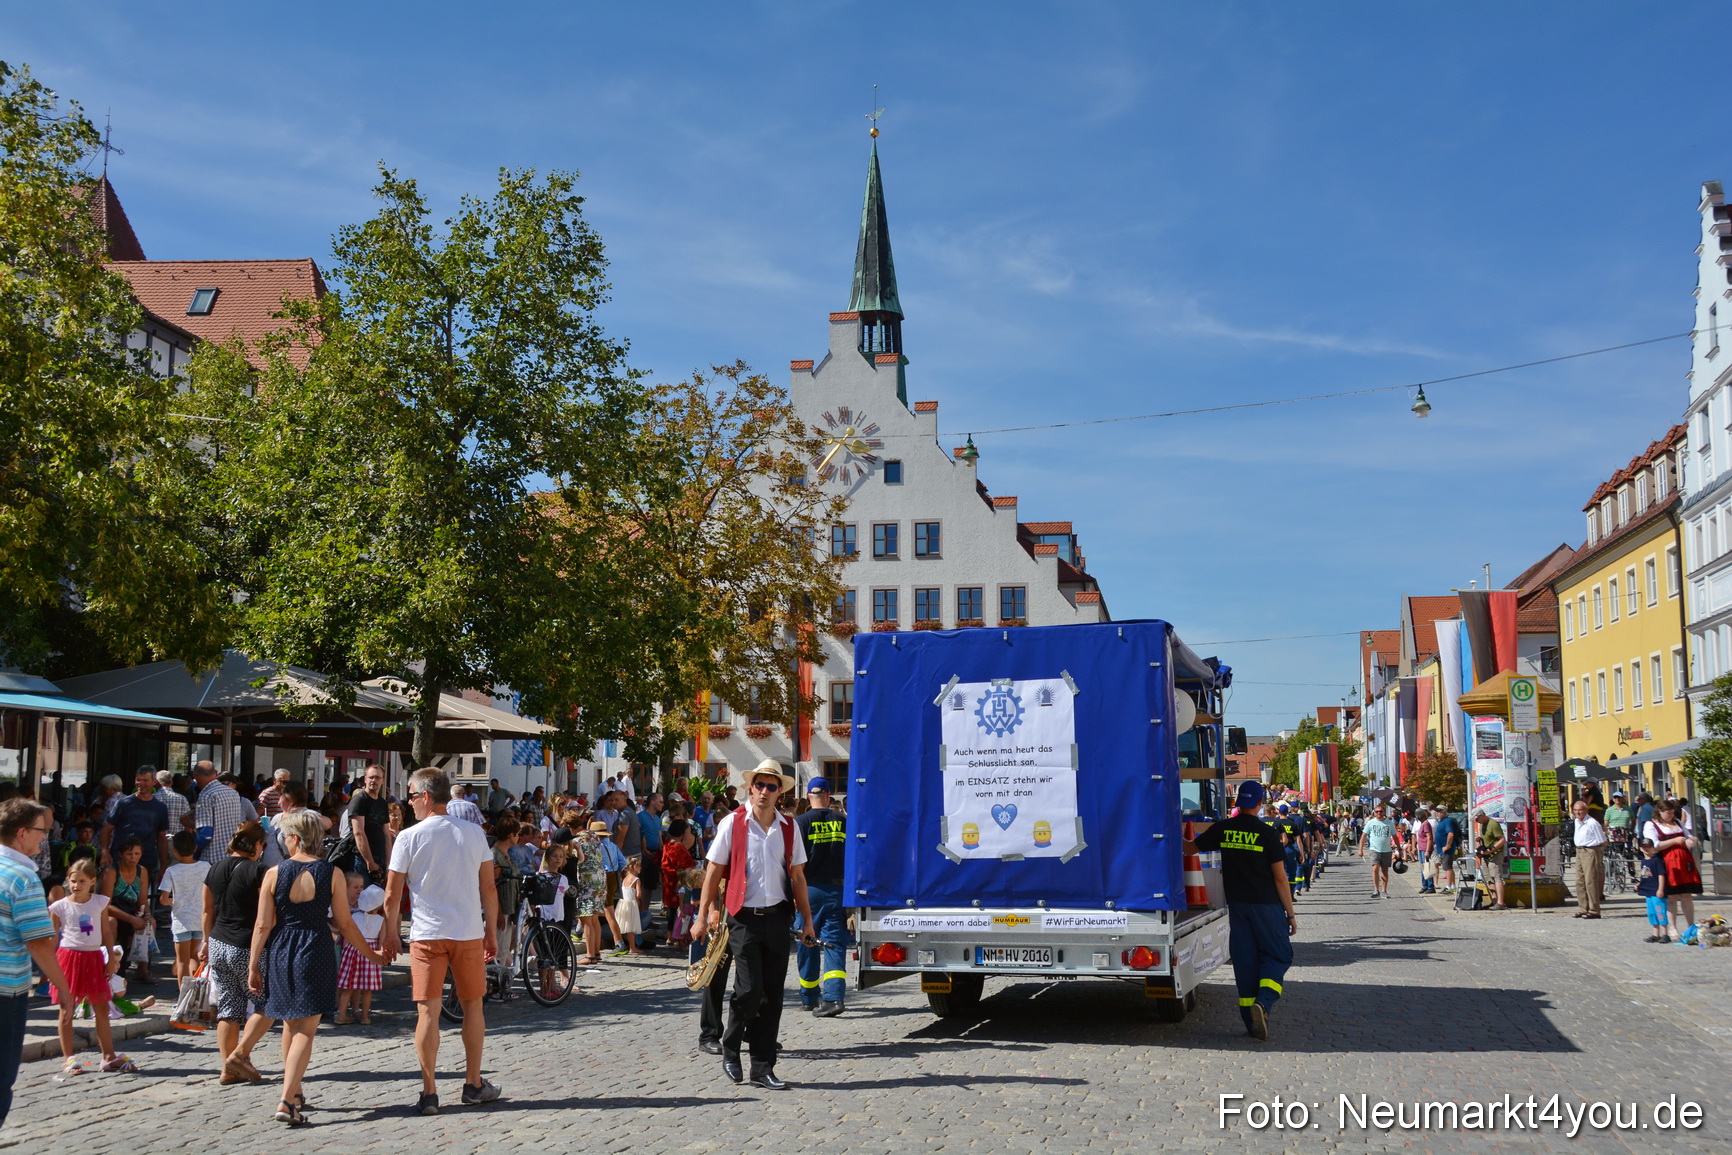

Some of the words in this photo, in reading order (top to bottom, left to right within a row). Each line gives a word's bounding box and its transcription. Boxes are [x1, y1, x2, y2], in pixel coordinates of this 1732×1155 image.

[954, 748, 973, 756] Auch
[968, 759, 1016, 768] Schlusslicht
[968, 777, 1010, 785] EINSATZ
[1013, 776, 1036, 784] stehn
[812, 820, 842, 832] THW
[1224, 830, 1259, 844] THW
[883, 918, 915, 927] #(Fast)
[1046, 917, 1126, 926] #WirFürNeumarkt
[984, 950, 997, 961] NM
[1006, 950, 1019, 961] HV
[1022, 950, 1049, 962] 2016
